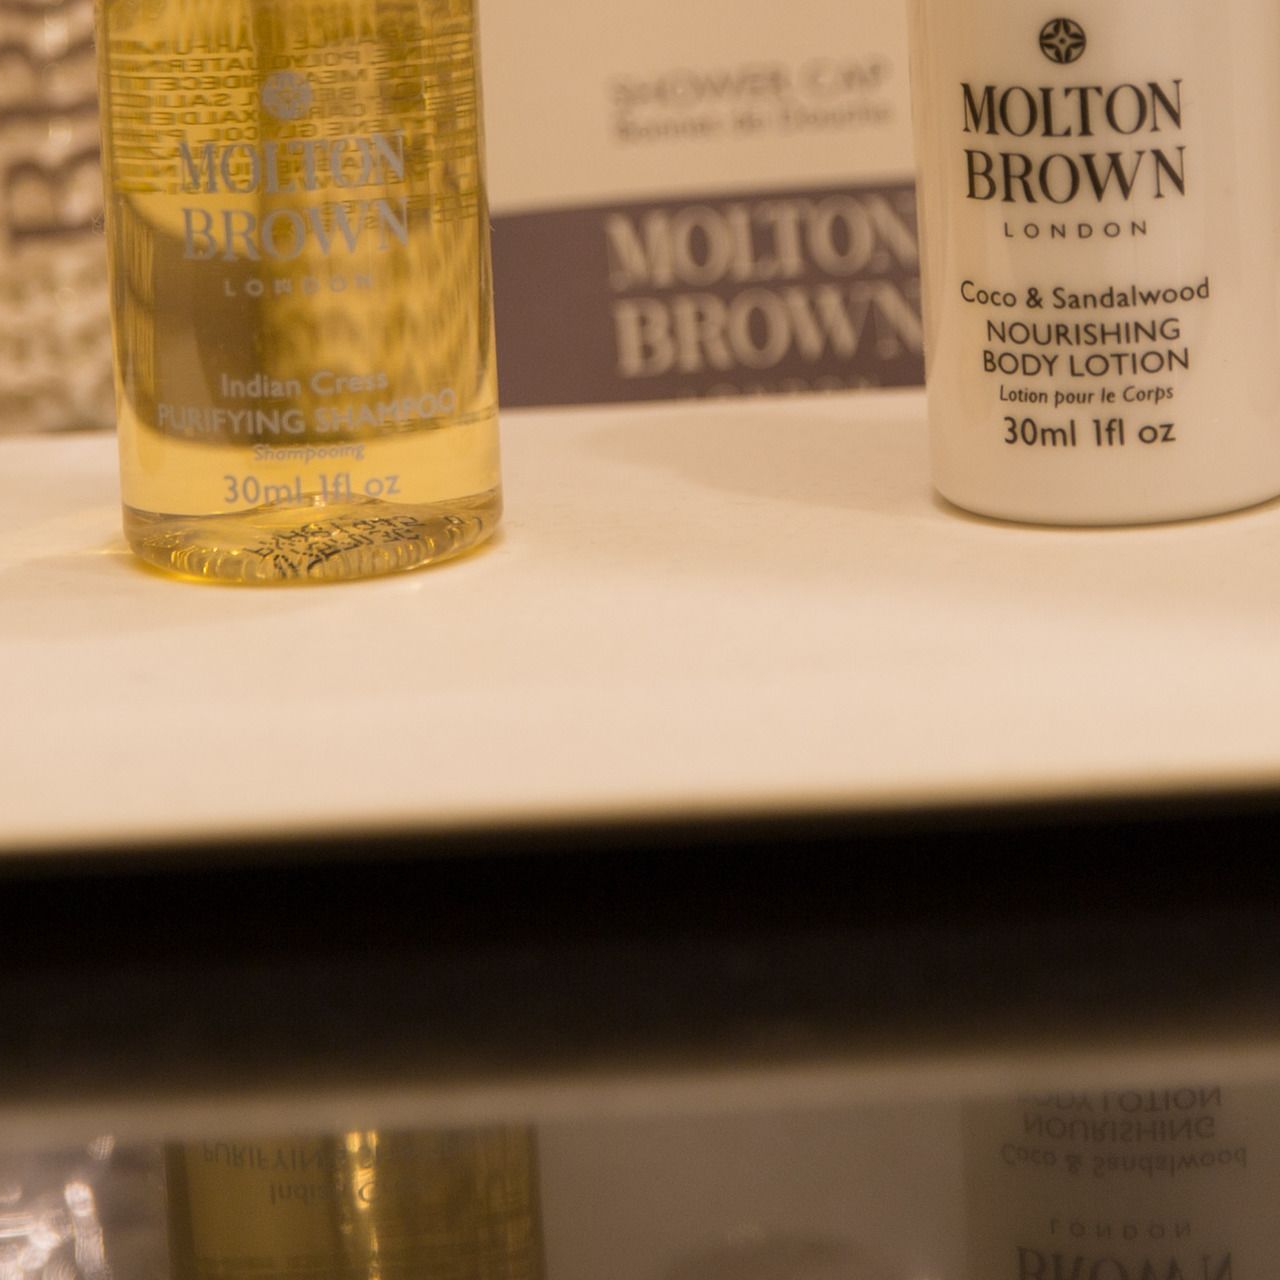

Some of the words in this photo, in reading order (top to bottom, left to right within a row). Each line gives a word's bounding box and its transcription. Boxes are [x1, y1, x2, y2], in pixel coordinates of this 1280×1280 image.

[959, 79, 1183, 138] MOLTON
[179, 130, 406, 196] MOLTON
[963, 146, 1186, 204] BROWN
[181, 197, 411, 263] BROWN
[1004, 220, 1148, 239] LONDON
[224, 275, 374, 297] LONDON
[960, 280, 1017, 308] Coco
[1025, 287, 1044, 309] &
[1052, 277, 1210, 310] Sandalwood
[986, 318, 1182, 347] NOURISHING
[983, 349, 1059, 377] BODY
[1069, 348, 1190, 378] LOTION
[222, 374, 301, 399] Indian
[310, 369, 389, 396] Cress
[1000, 384, 1049, 405] Lotion
[1054, 388, 1095, 408] pour
[1101, 385, 1116, 405] le
[1122, 384, 1174, 405] Corps
[158, 404, 306, 436] PURIFYING
[314, 388, 458, 434] SHAMPOO
[1003, 416, 1077, 447] 30ml
[1138, 422, 1177, 445] oz
[253, 442, 366, 464] Shampooing
[223, 475, 303, 505] 30ml
[364, 473, 401, 497] oz
